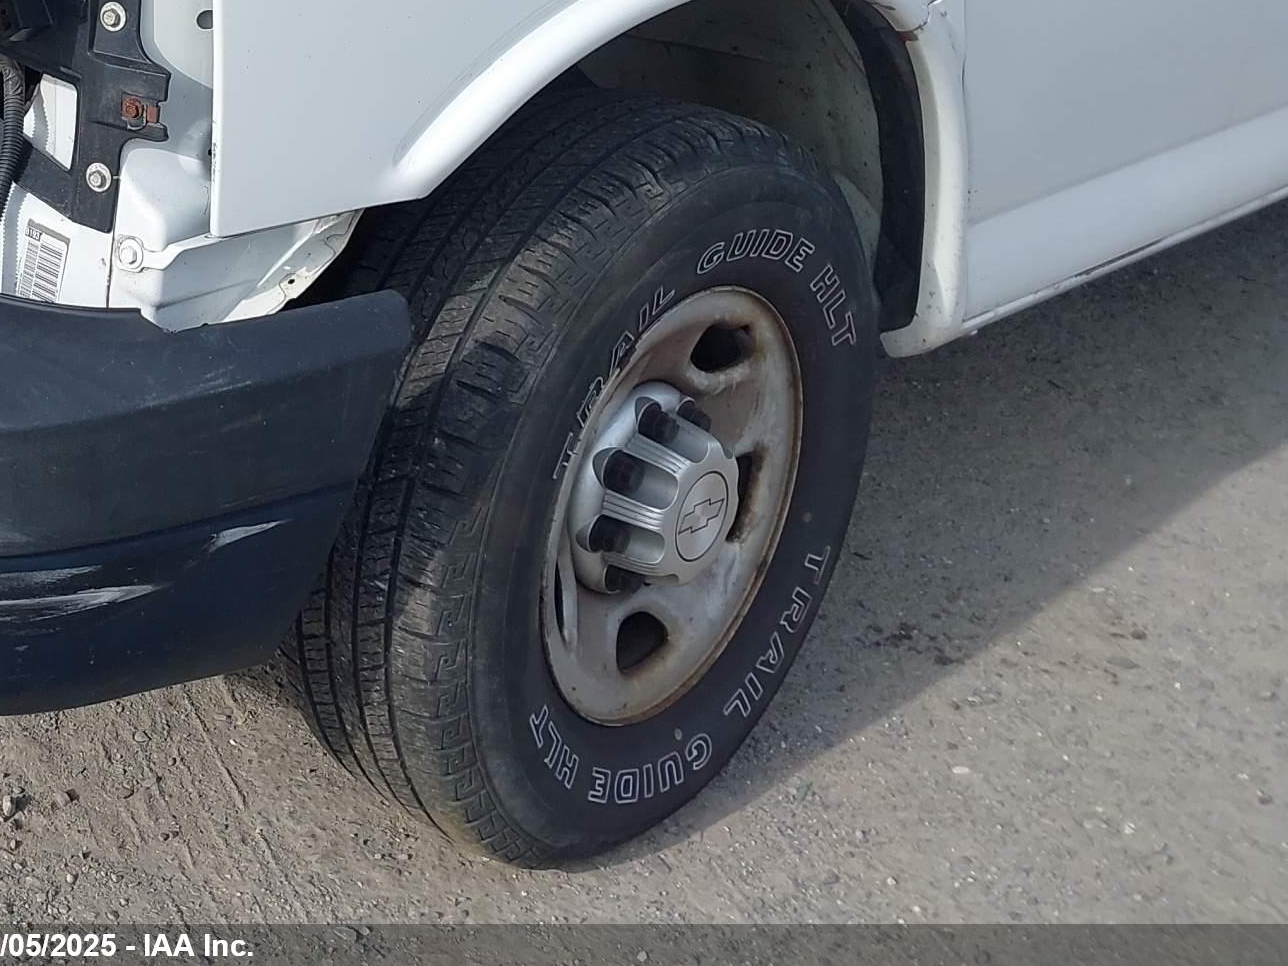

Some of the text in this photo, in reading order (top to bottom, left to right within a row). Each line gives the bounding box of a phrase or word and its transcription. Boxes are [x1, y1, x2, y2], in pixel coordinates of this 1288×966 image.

[553, 229, 857, 479] TRAIL GUIDE HLT
[529, 545, 831, 803] TRAIL GUIDE HLT
